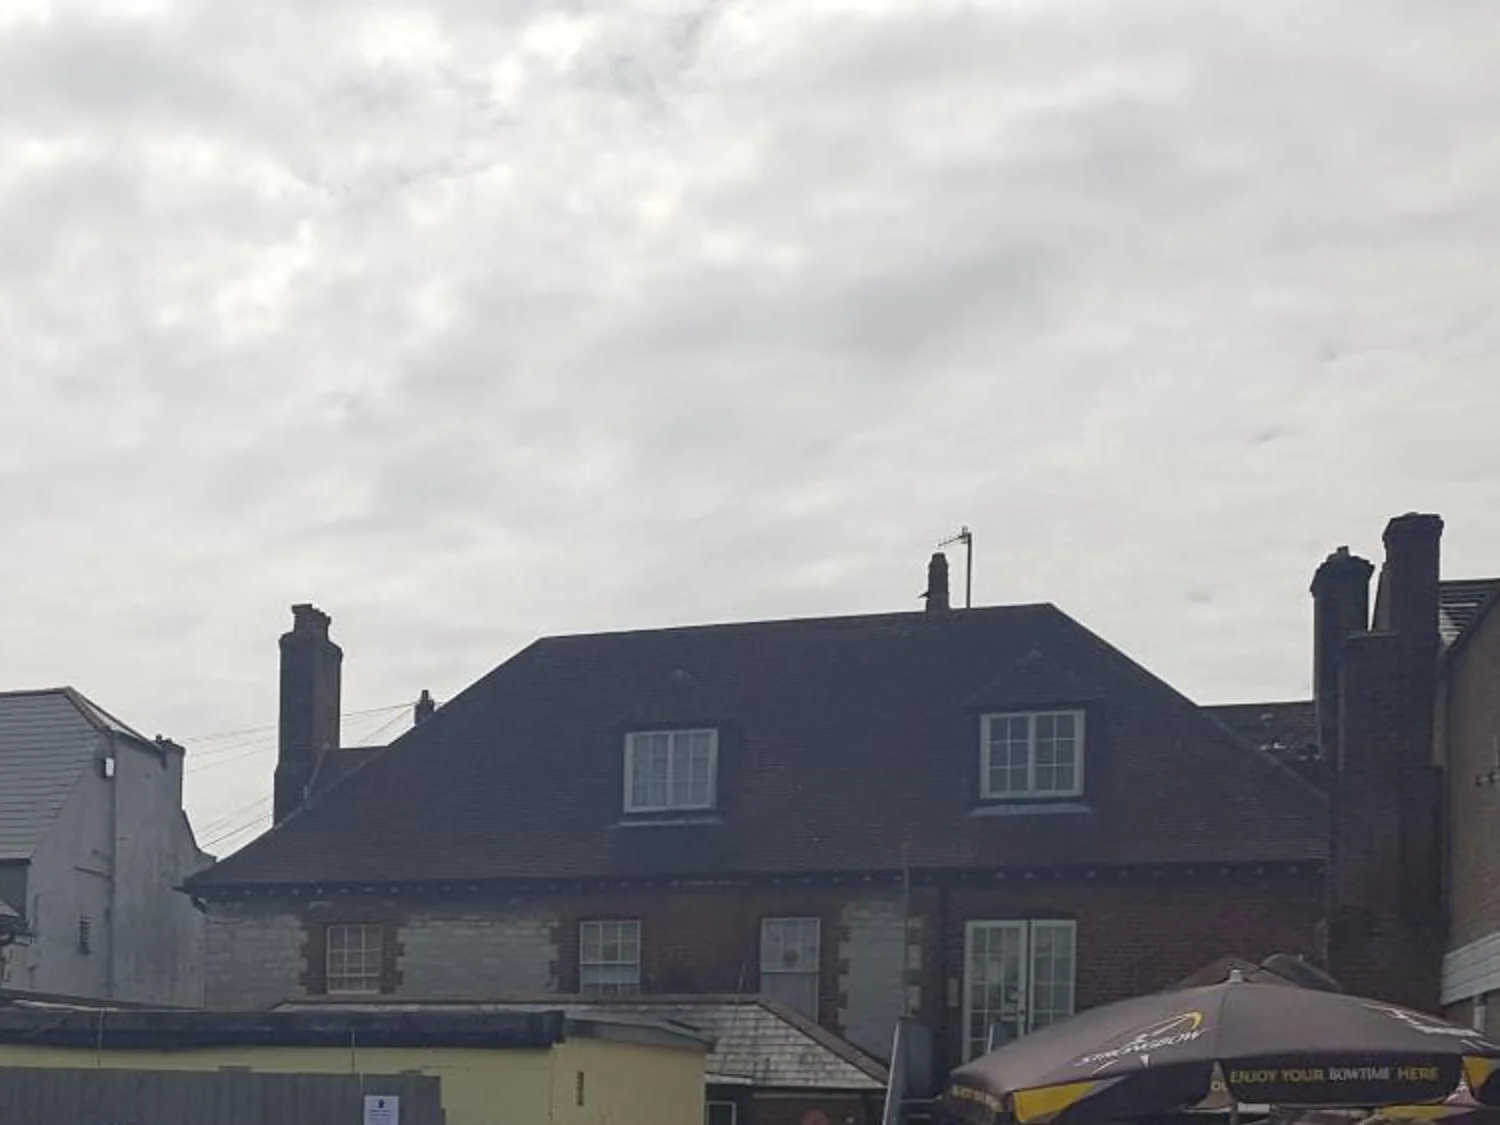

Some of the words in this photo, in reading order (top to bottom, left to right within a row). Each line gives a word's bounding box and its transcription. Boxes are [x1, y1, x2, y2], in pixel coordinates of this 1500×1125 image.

[1230, 1068, 1277, 1083] ENJOY
[1281, 1068, 1324, 1082] YOUR
[1397, 1067, 1439, 1081] HERE
